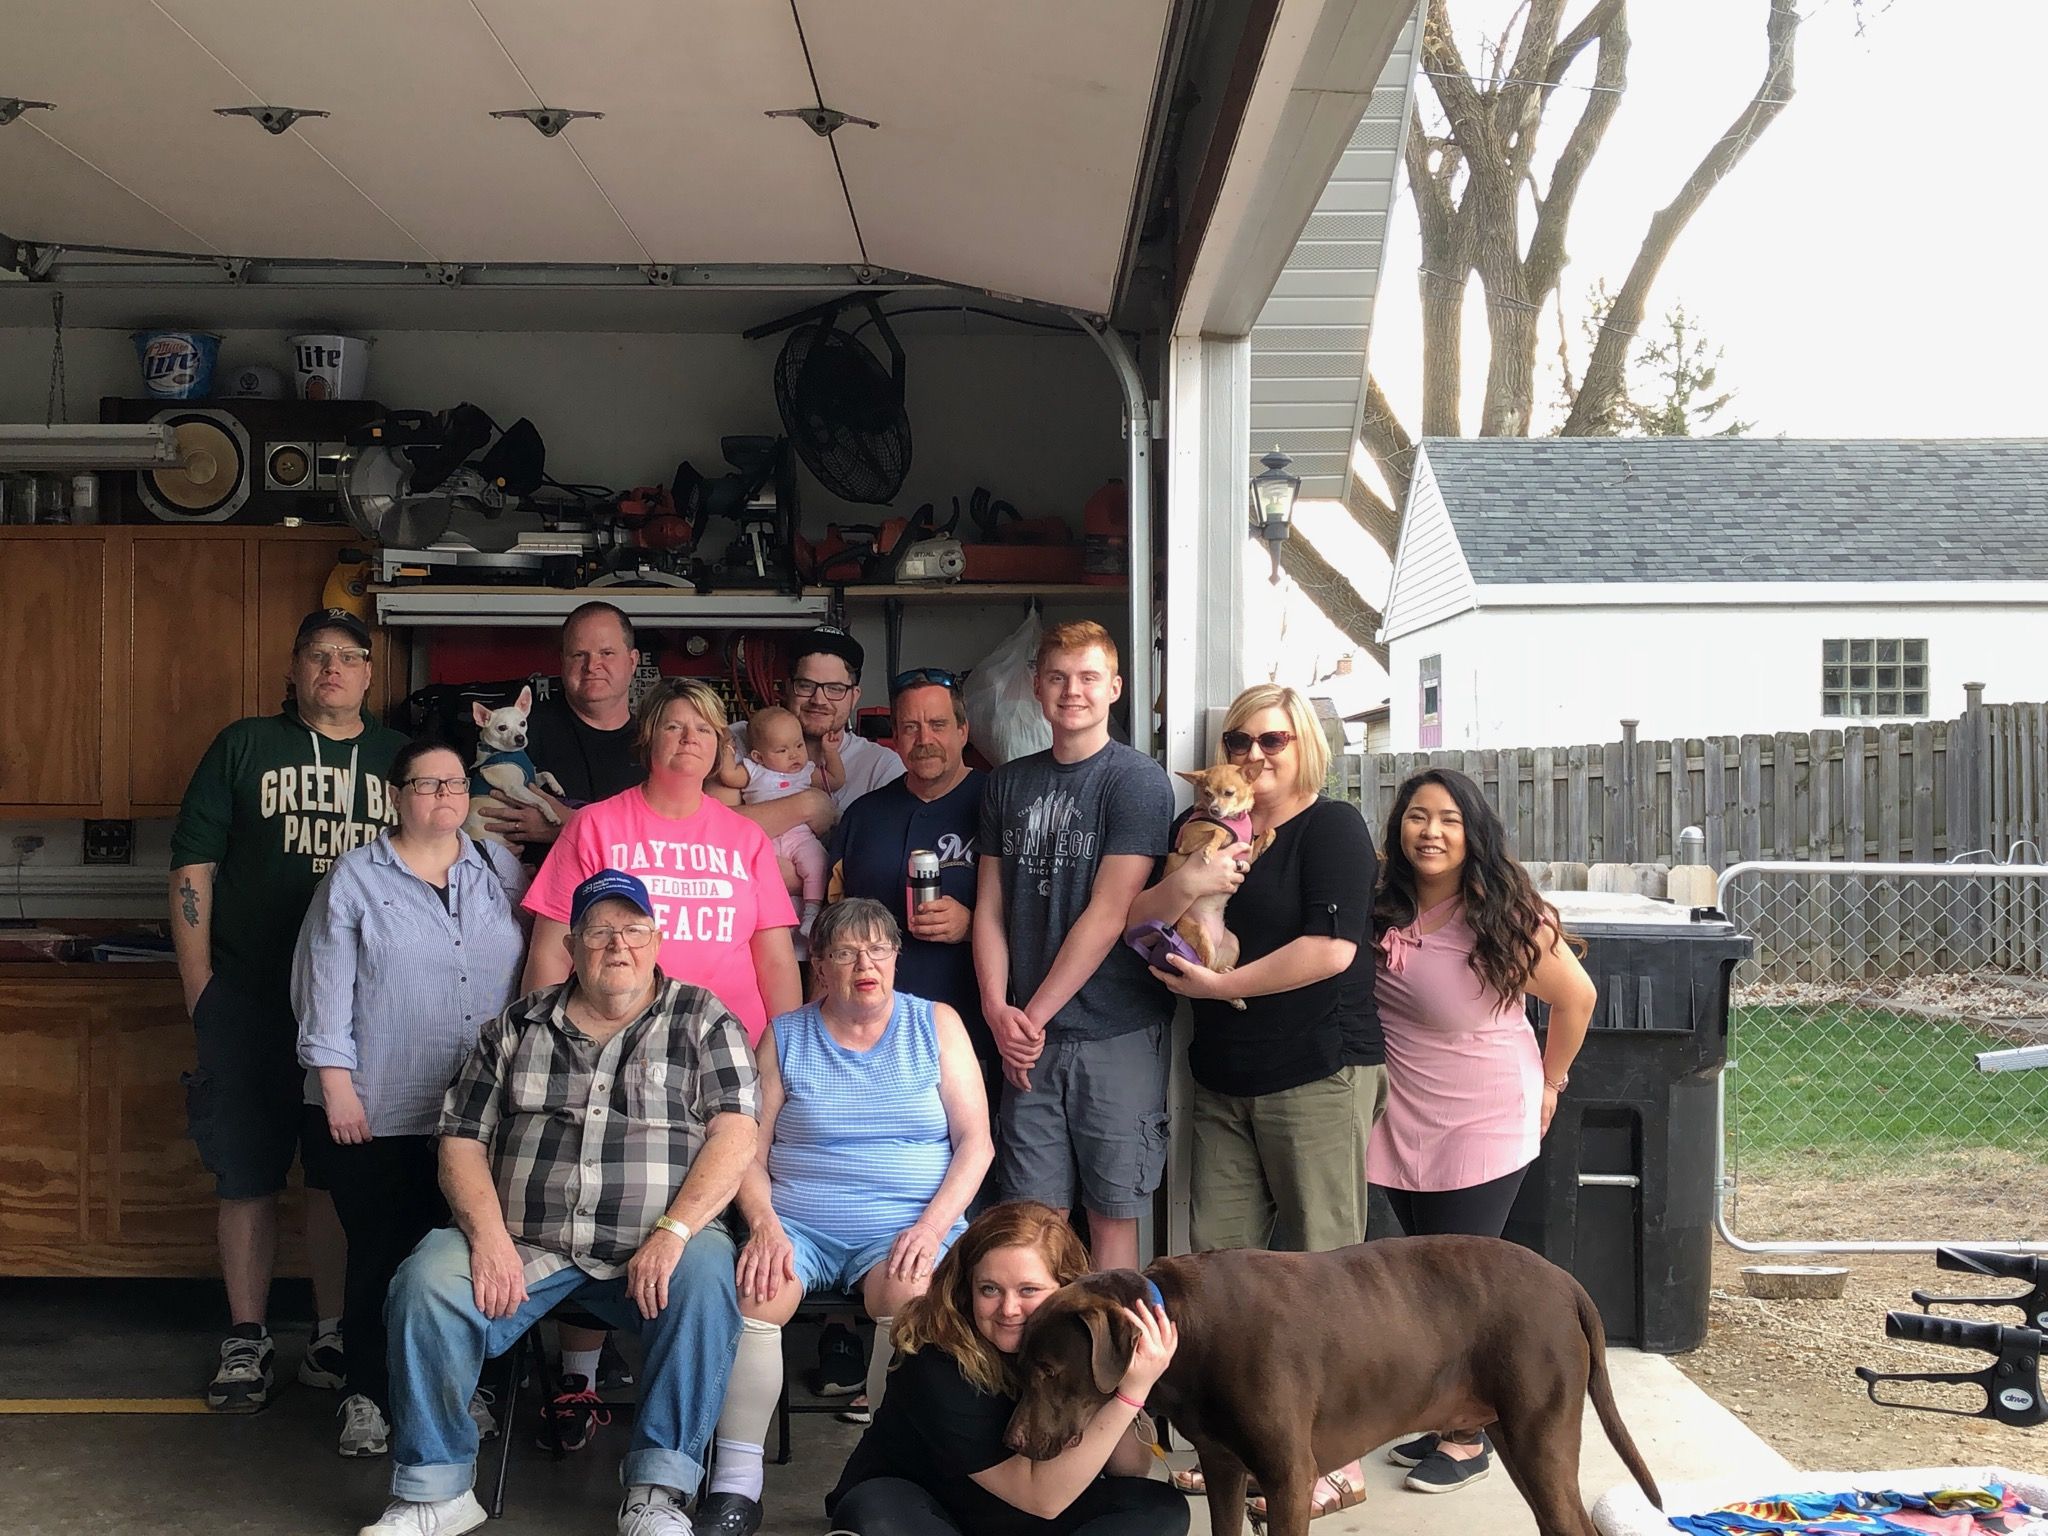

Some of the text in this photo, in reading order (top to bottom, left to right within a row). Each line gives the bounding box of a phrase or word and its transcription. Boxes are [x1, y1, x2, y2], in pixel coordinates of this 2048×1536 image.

[146, 352, 201, 380] Lite
[296, 345, 341, 374] Lite
[261, 765, 399, 826] GREEN BA
[284, 814, 388, 857] PACKER
[1045, 830, 1097, 860] DEGO
[611, 839, 749, 882] DAYTONA
[651, 878, 720, 896] FLORIDA
[653, 903, 737, 943] EACH
[2004, 1394, 2029, 1405] drive
